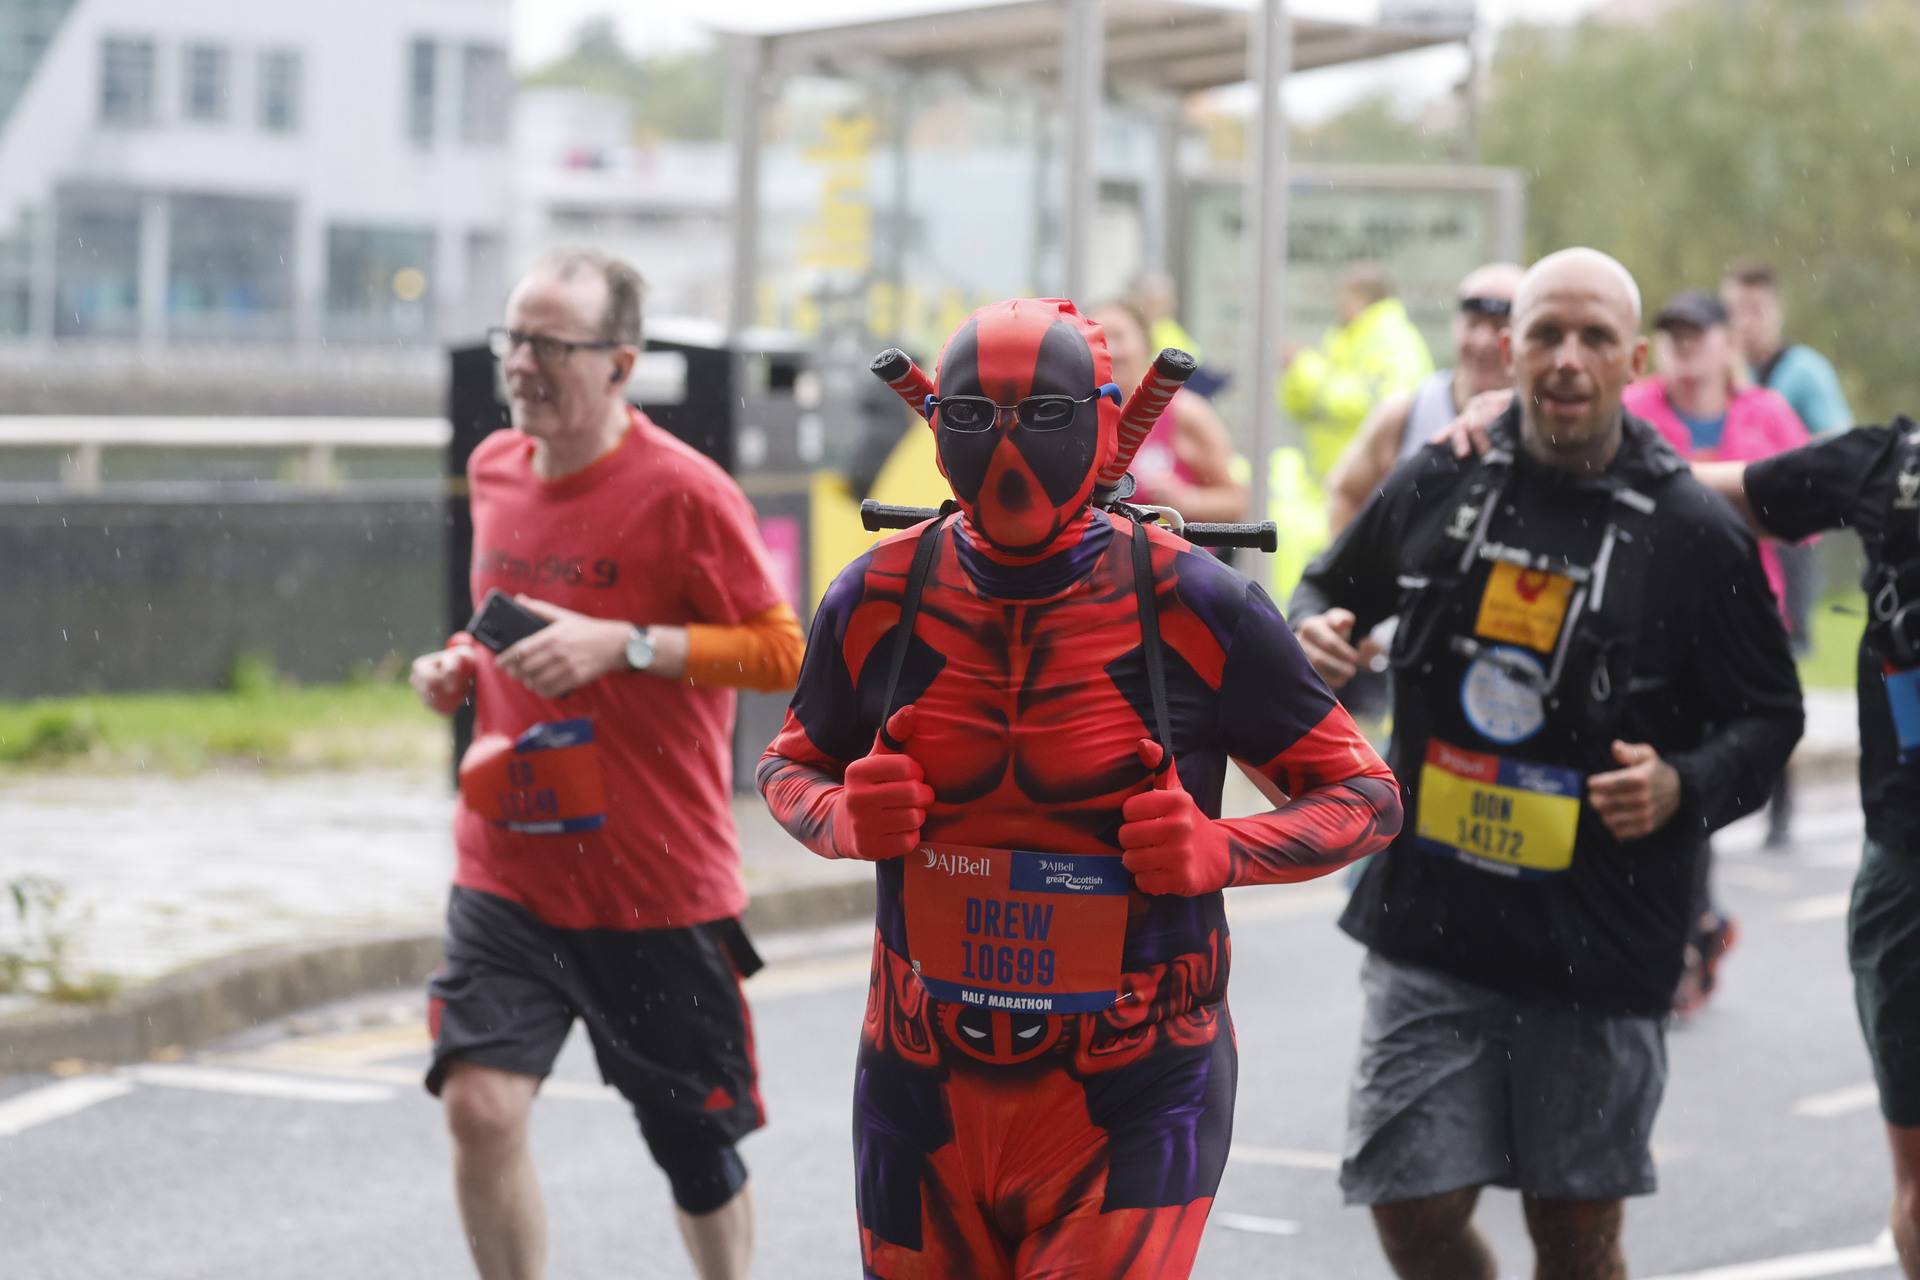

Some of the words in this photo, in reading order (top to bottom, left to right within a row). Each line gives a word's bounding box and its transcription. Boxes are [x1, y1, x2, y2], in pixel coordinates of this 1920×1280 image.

[1458, 817, 1524, 858] 14172
[1046, 875, 1066, 885] great
[1072, 876, 1103, 885] scottish
[966, 898, 1054, 942] DREW
[960, 941, 1056, 987] 10699
[961, 991, 985, 1005] HALF
[988, 993, 1052, 1010] MARATHON
